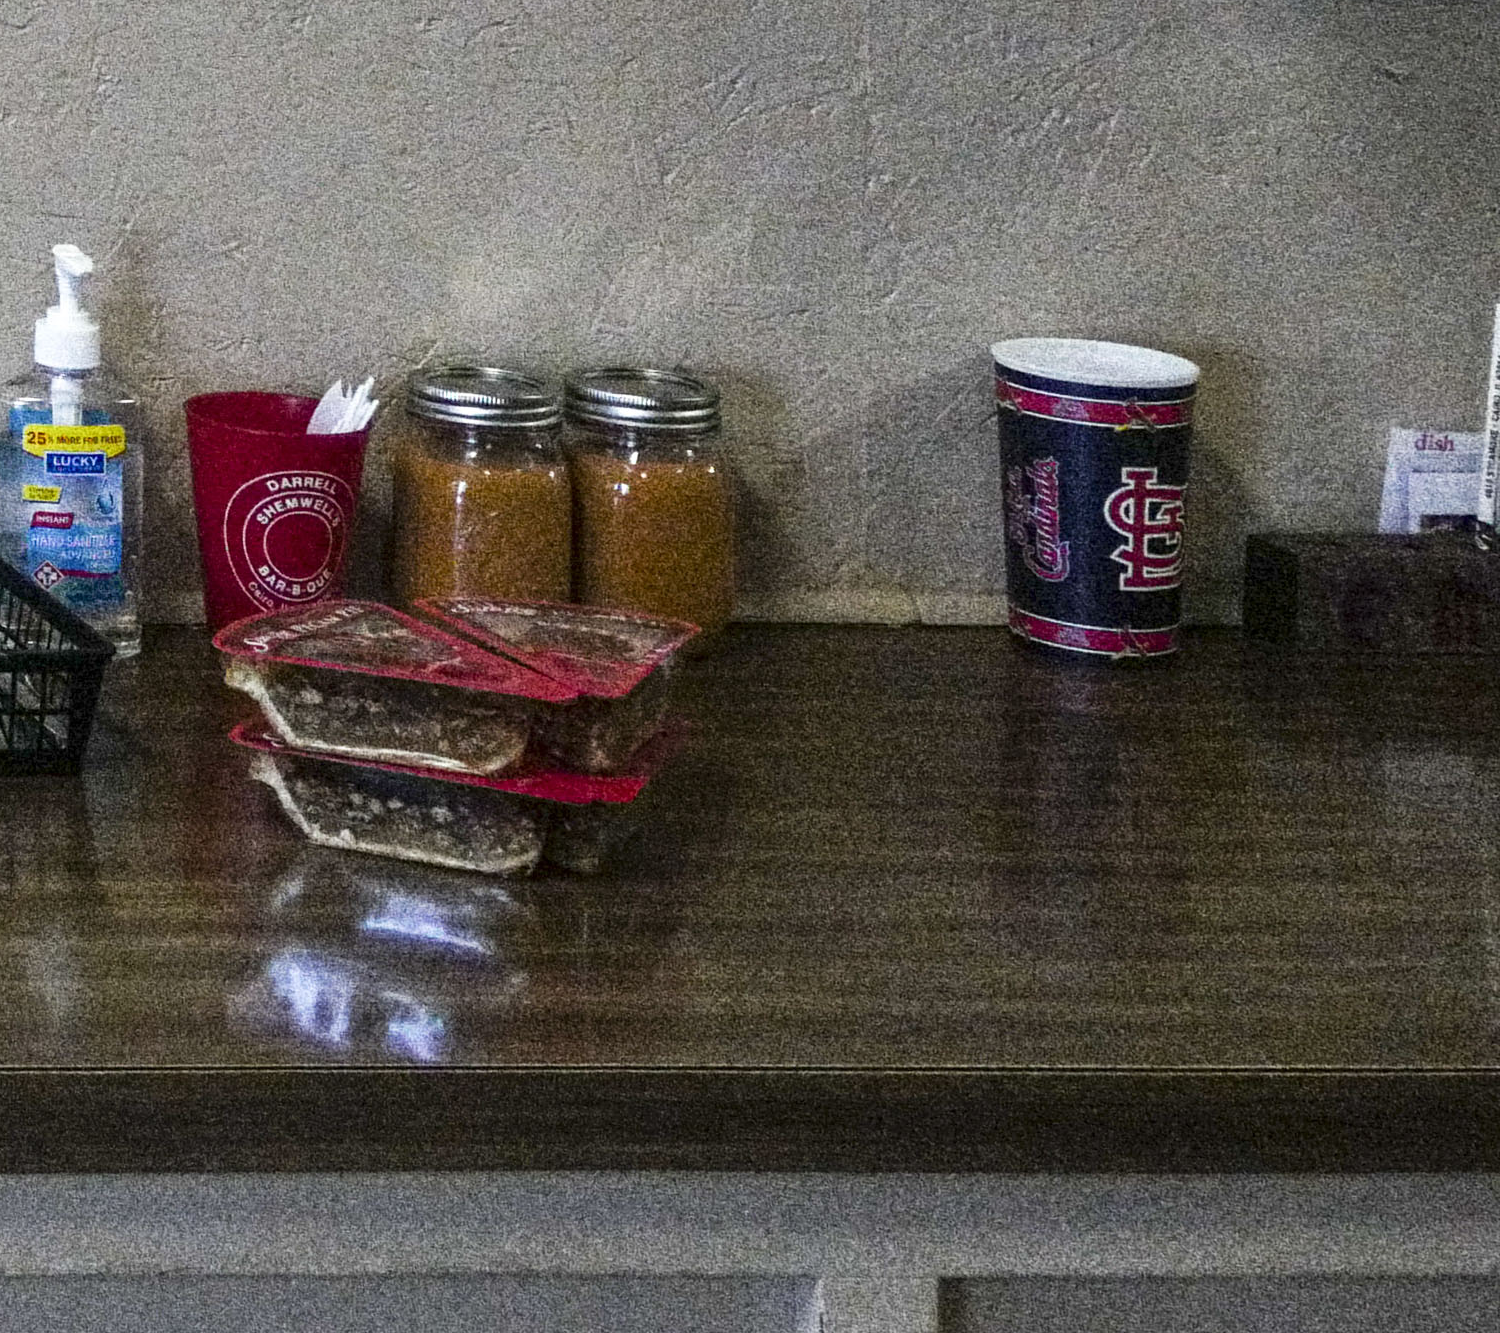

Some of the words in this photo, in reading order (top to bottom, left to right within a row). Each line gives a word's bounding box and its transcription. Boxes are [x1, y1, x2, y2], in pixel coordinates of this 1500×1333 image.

[1414, 433, 1455, 453] dish
[52, 455, 99, 467] LUCKY
[266, 476, 338, 496] DARRELL
[1023, 455, 1071, 583] Cardinals
[31, 534, 63, 549] HAND
[257, 564, 333, 596] BAR-B-QUE
